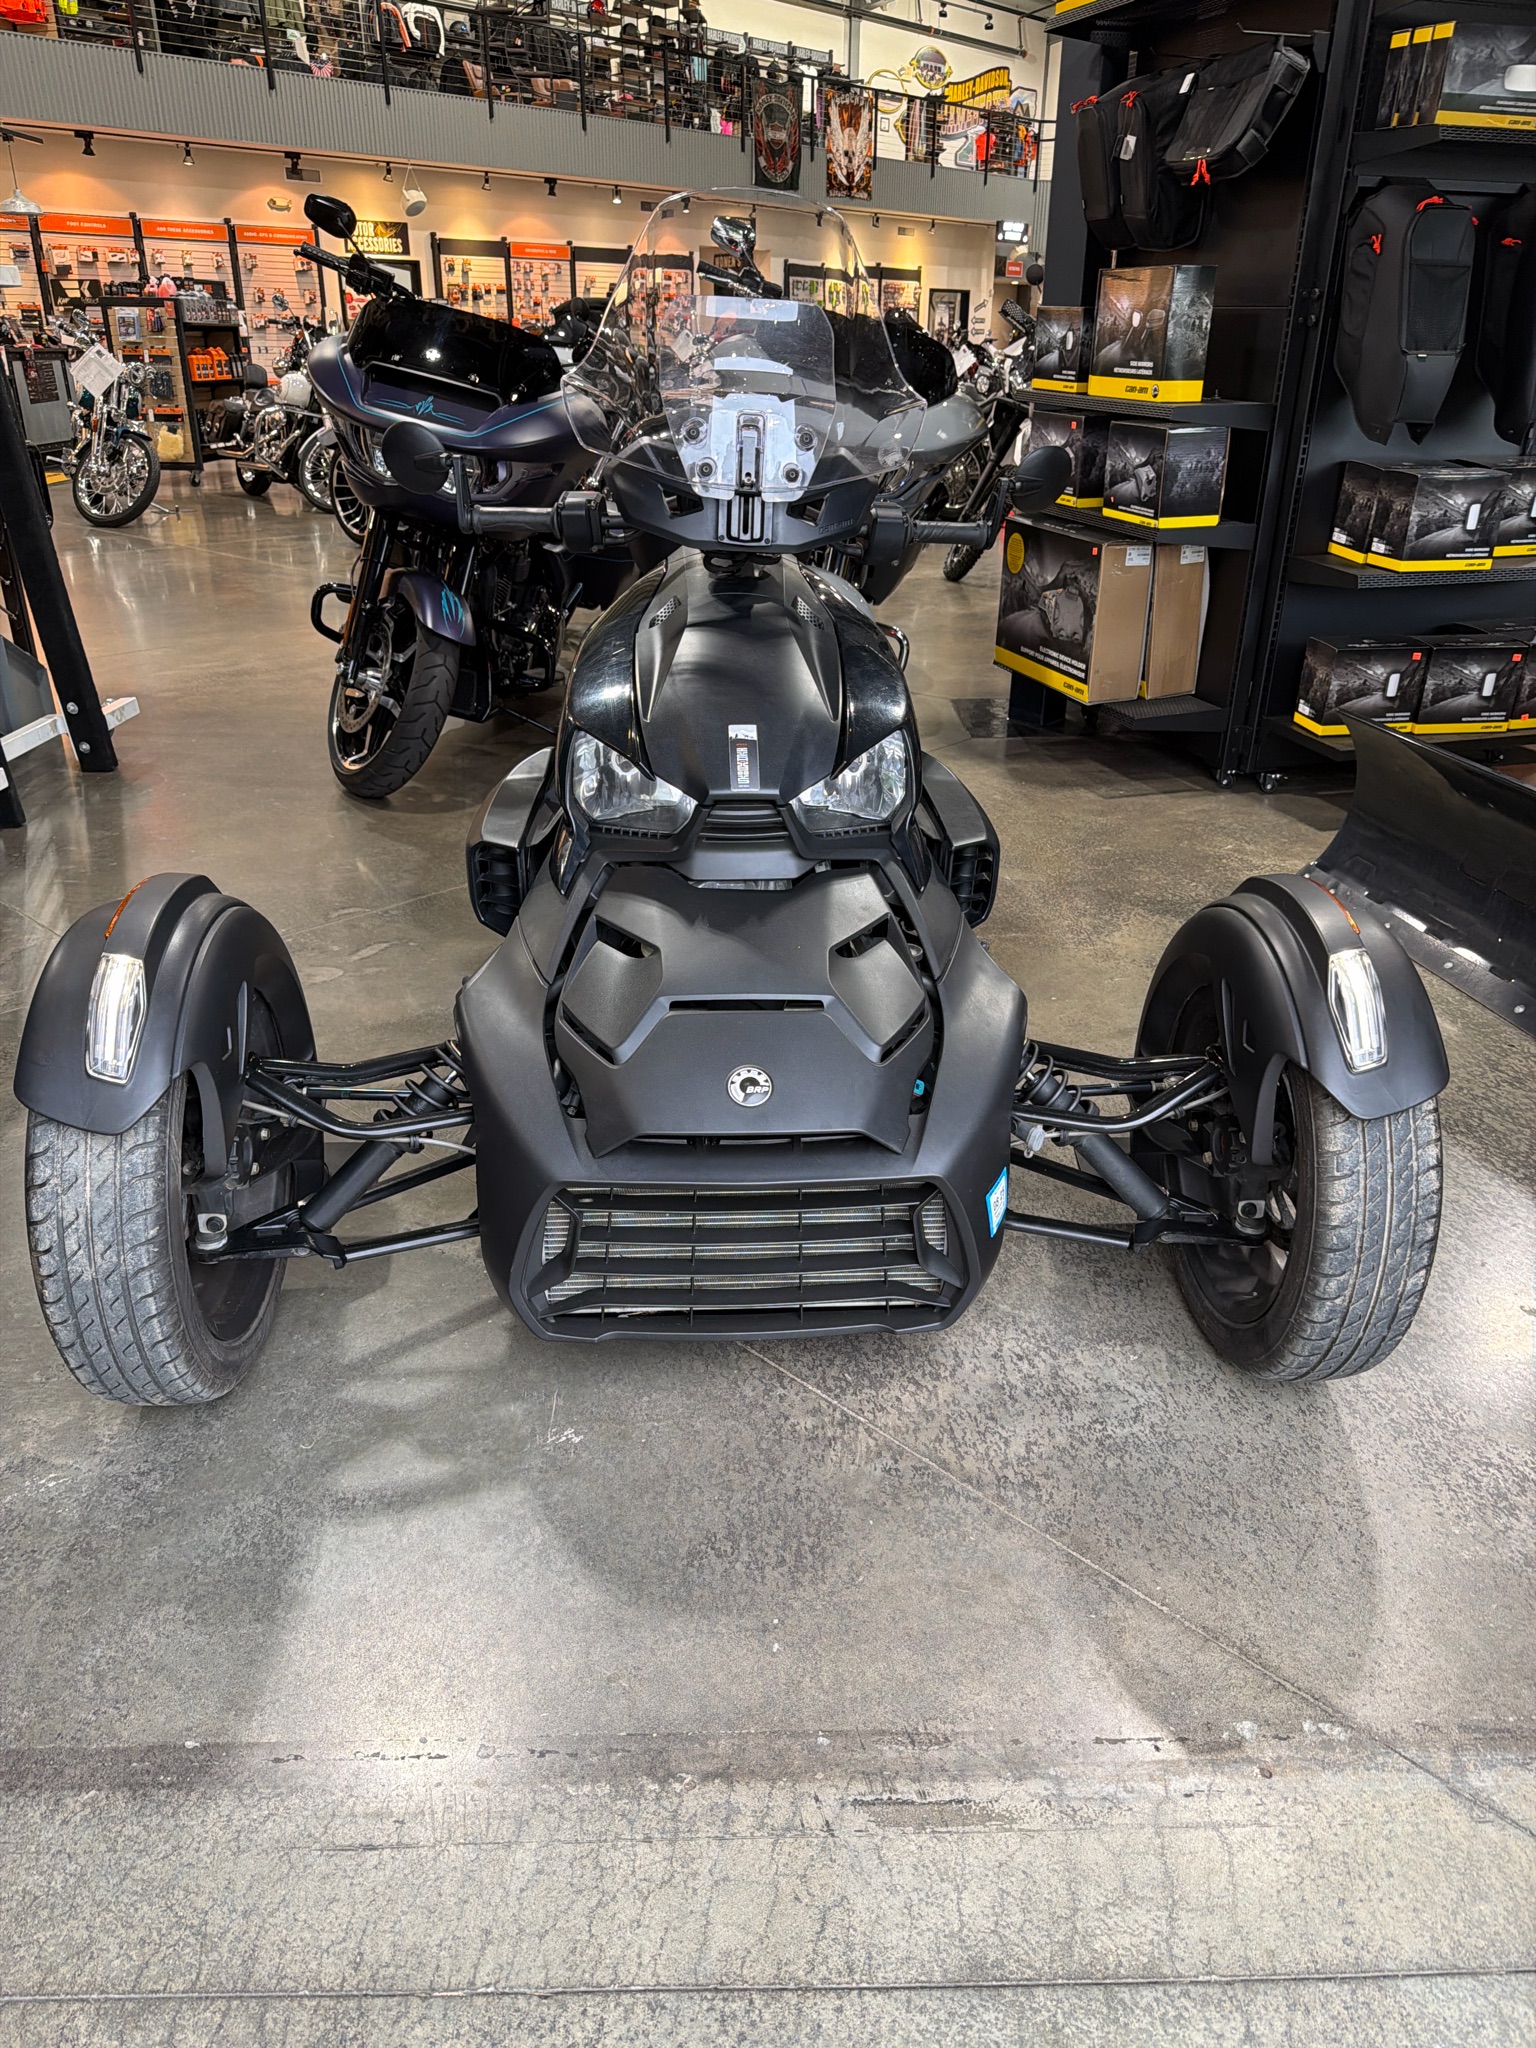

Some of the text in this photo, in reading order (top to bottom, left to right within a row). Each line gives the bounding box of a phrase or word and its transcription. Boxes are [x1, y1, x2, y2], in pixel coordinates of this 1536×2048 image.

[352, 221, 375, 237] OTOR
[1125, 385, 1149, 394] can-am
[1063, 681, 1084, 696] can-am
[745, 1086, 770, 1094] BRP
